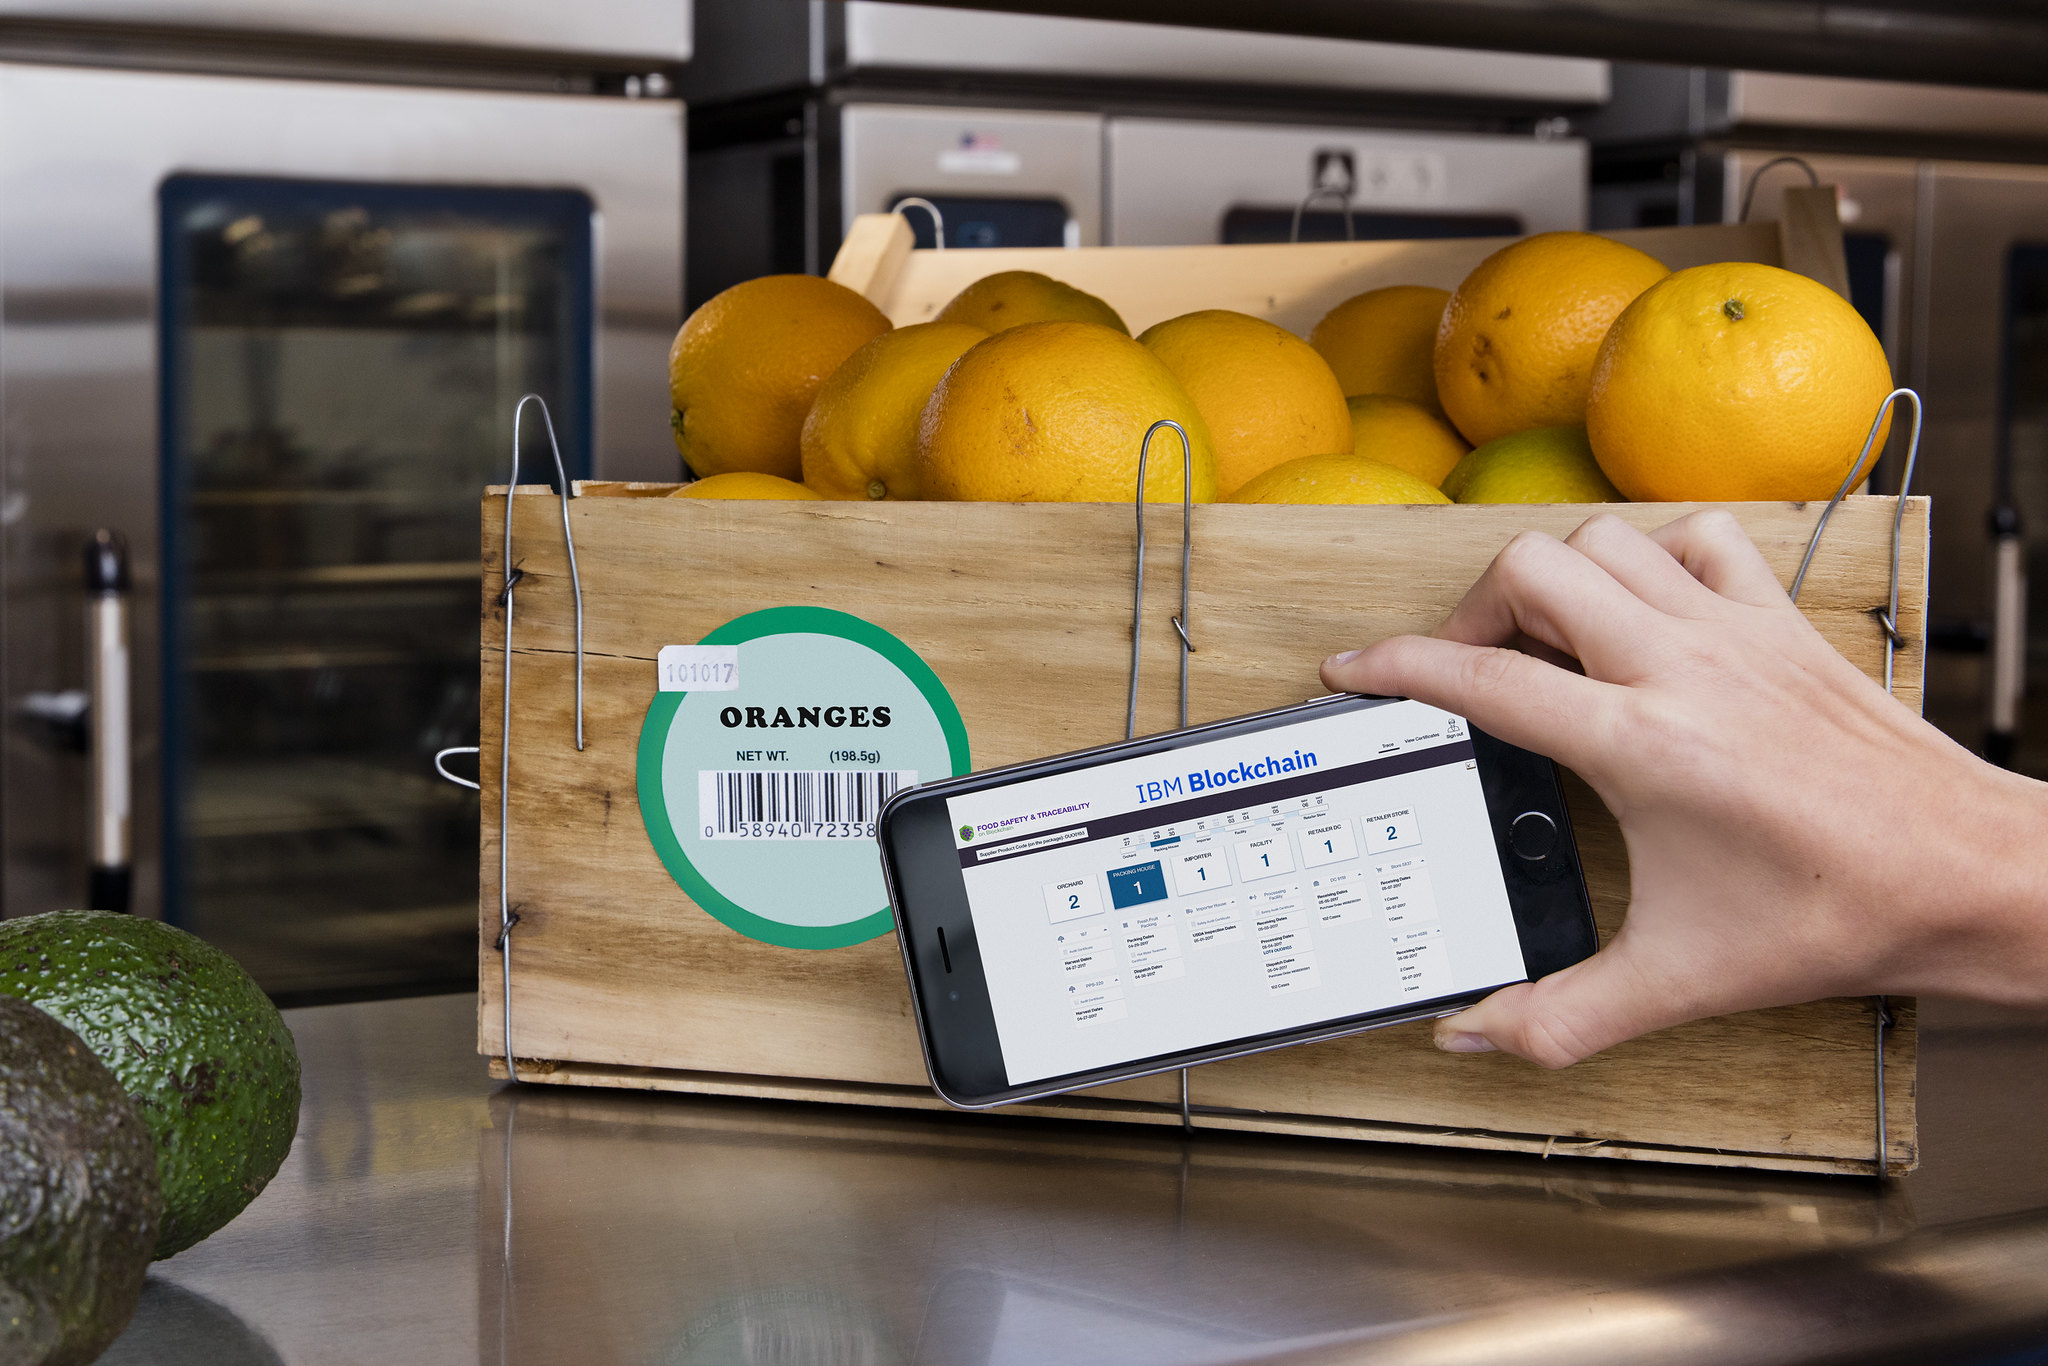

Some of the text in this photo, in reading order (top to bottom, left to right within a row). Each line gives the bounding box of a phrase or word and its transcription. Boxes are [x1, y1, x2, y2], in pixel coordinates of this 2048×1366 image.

[666, 663, 734, 684] 101017
[720, 706, 891, 728] ORANGES
[737, 750, 881, 764] NET WT. (198.5g)
[1135, 750, 1318, 804] IBM Blockchain
[977, 822, 998, 831] FOOD
[1000, 815, 1028, 826] SAFETY
[1037, 802, 1090, 818] TRACEABILITY
[1366, 809, 1410, 823] RETAILER STORE
[739, 823, 802, 838] 58940
[814, 822, 876, 838] 72358
[1307, 826, 1333, 836] RETAILER
[1386, 825, 1398, 841] 2
[1250, 839, 1273, 848] FACILITY
[1324, 839, 1333, 853] 1
[1184, 852, 1212, 863] IMPORTER
[1261, 853, 1270, 867] 1
[1112, 864, 1156, 878] PACKING HOUSE
[1197, 867, 1206, 881] 1
[1056, 880, 1084, 890] ORCHARD
[1133, 881, 1142, 895] 1
[1068, 895, 1081, 910] 2
